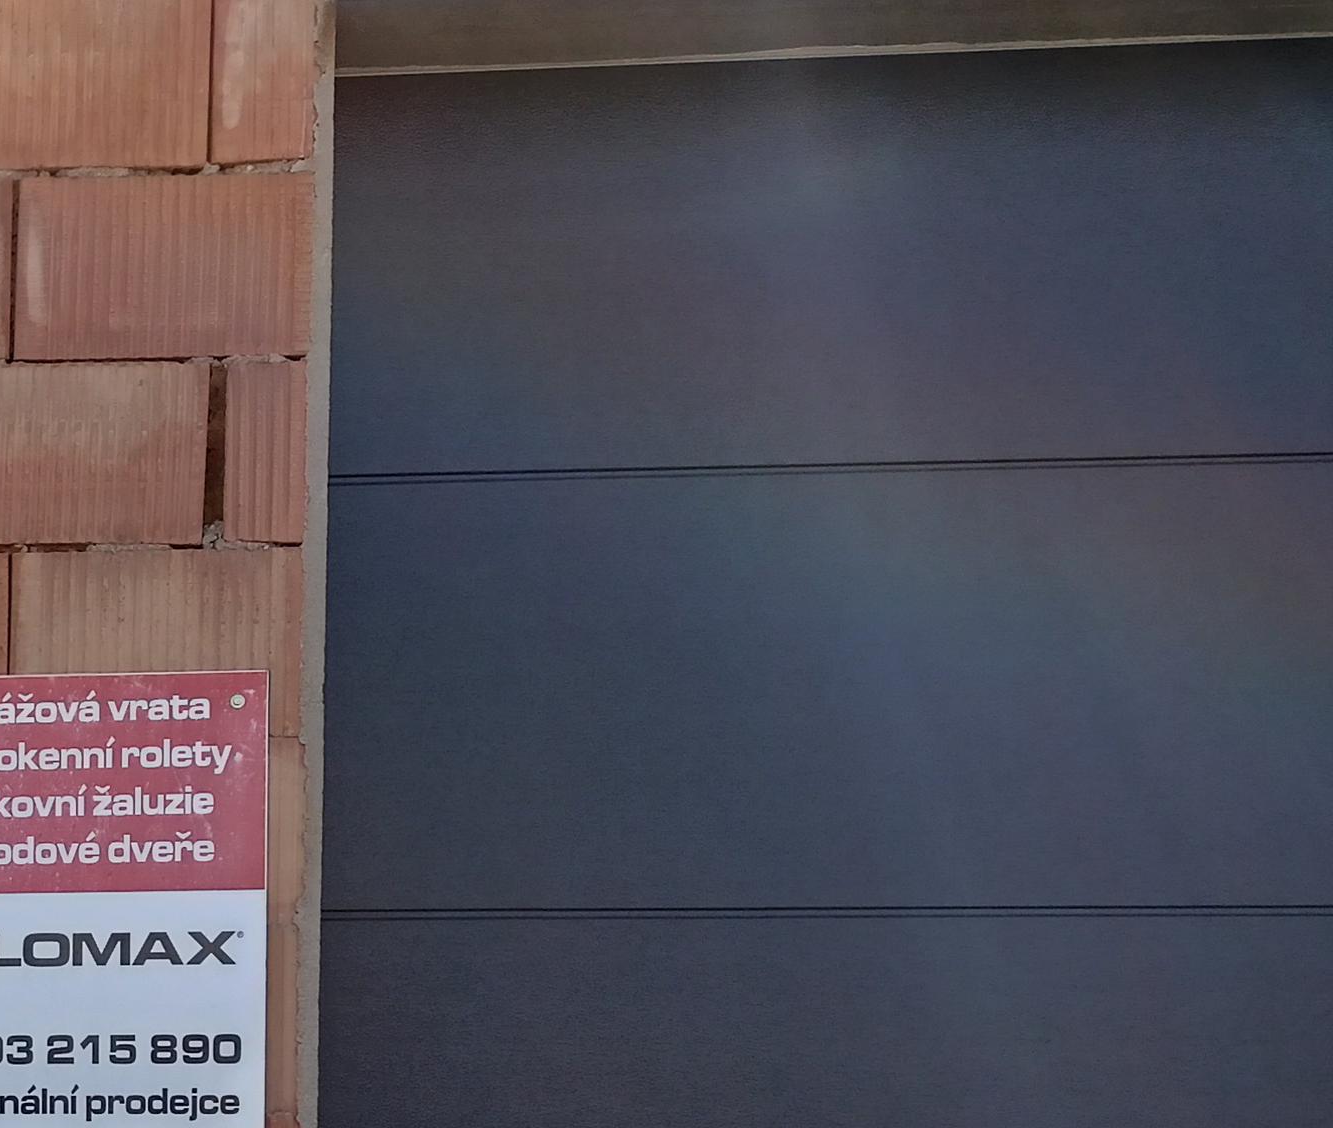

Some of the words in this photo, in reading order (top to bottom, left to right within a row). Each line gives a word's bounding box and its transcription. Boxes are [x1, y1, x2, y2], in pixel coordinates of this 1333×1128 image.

[108, 695, 210, 721] vrata
[122, 739, 232, 774] rolety
[93, 785, 214, 816] žaluzie
[108, 831, 215, 862] dveře
[47, 1035, 136, 1064] 215
[150, 1034, 242, 1064] 890
[86, 1088, 240, 1122] prodejce
